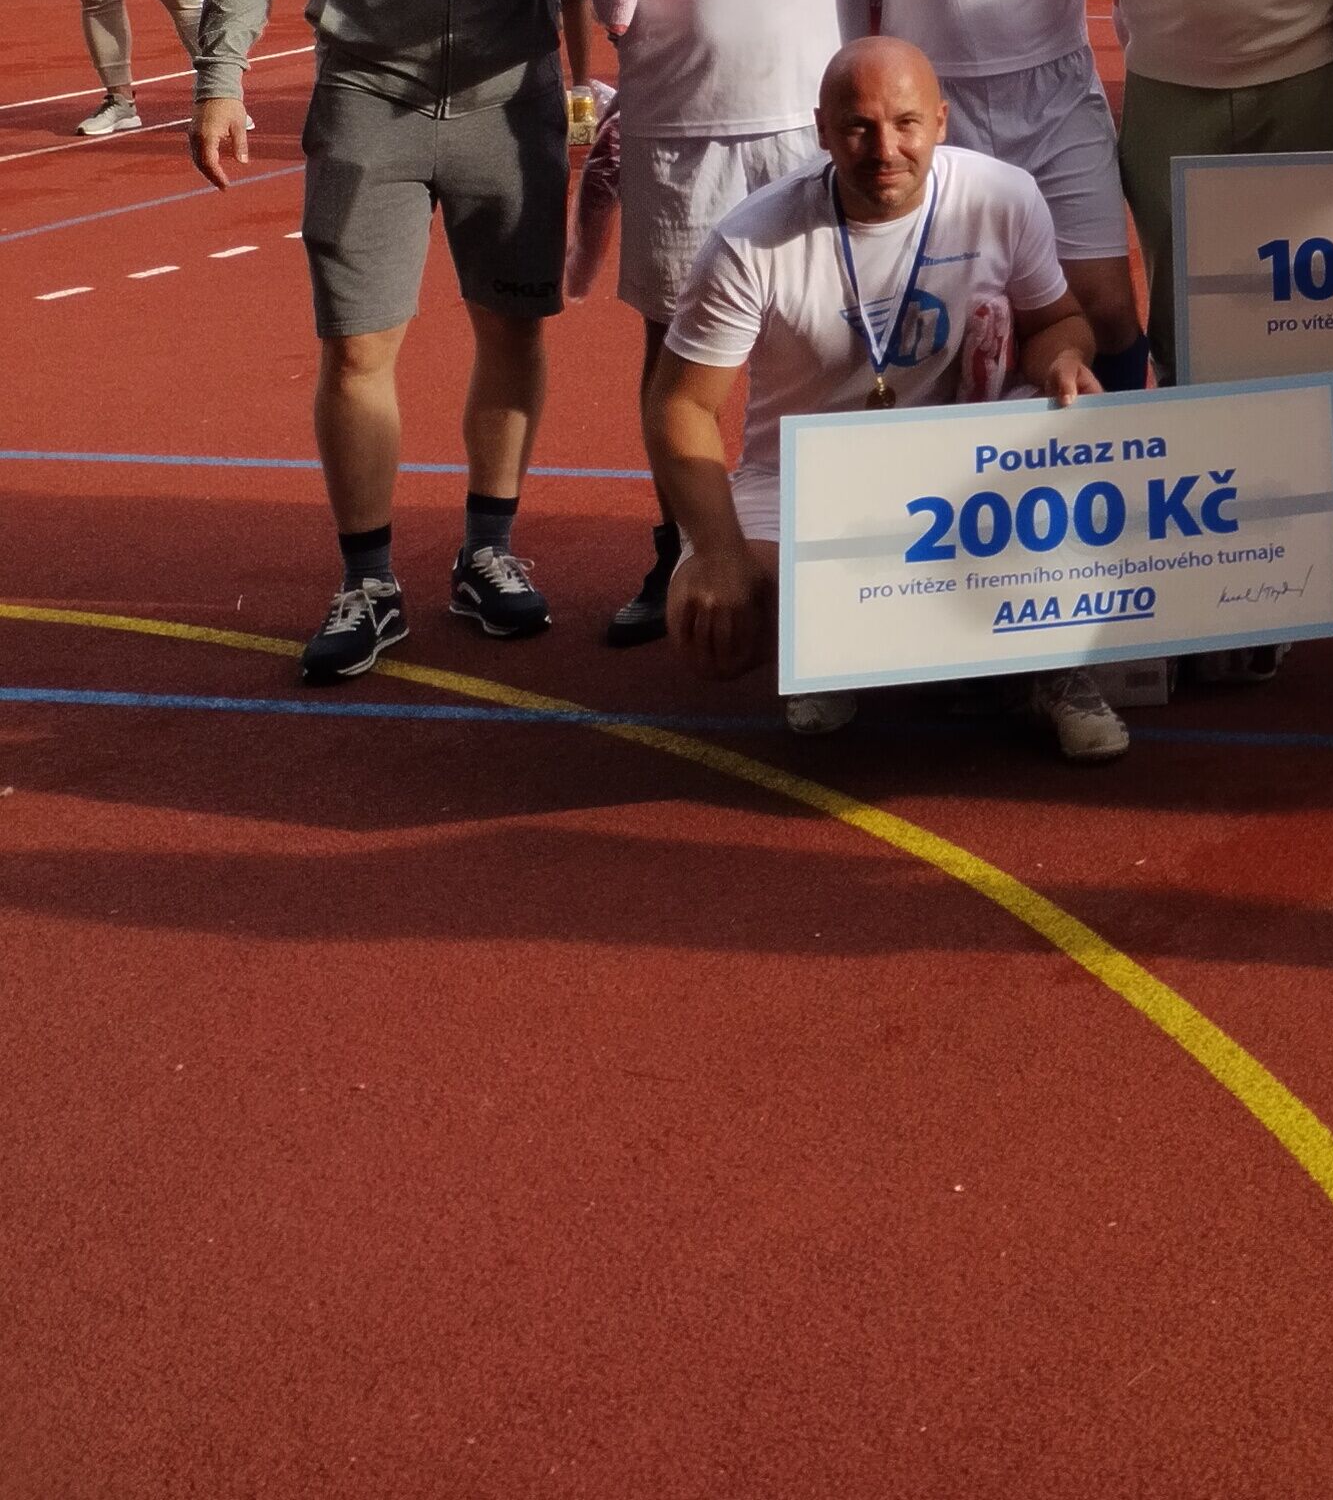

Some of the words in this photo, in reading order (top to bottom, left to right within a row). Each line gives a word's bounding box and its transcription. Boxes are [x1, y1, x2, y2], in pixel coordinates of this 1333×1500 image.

[1267, 317, 1299, 335] pro
[975, 437, 1113, 474] Poukaz
[1122, 435, 1167, 462] na
[904, 480, 1127, 564] 2000
[1148, 468, 1239, 540] Kč
[858, 582, 893, 604] pro
[898, 573, 957, 597] vítěze
[965, 564, 1065, 592] firemního
[1068, 550, 1214, 585] nohejbalového
[1217, 542, 1285, 568] turnaje
[993, 597, 1062, 627] AAA
[1071, 585, 1157, 619] AUTO
